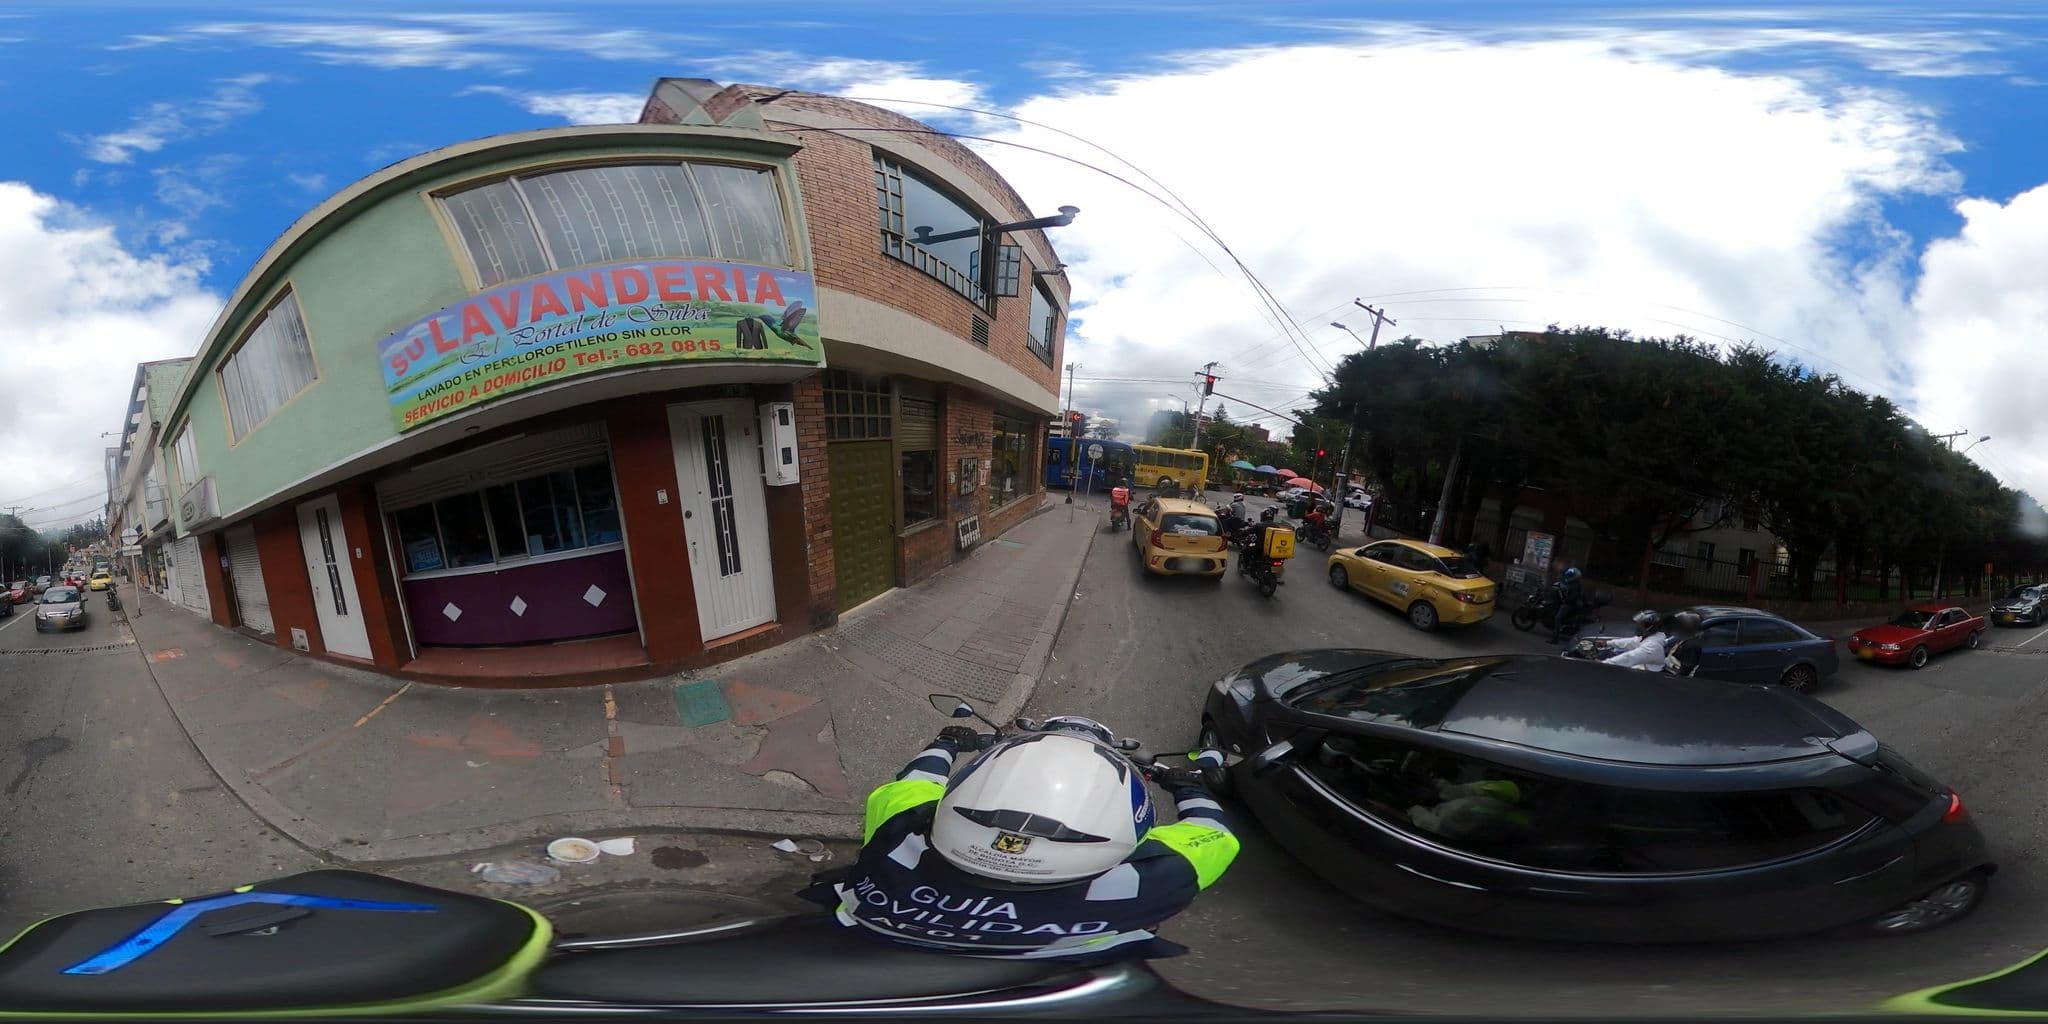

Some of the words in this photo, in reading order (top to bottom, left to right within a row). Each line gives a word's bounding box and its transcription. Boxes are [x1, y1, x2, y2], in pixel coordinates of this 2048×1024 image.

[428, 265, 786, 355] LAVANDERIA
[459, 336, 500, 365] El
[509, 314, 585, 348] Portal
[590, 308, 616, 330] de
[625, 303, 712, 324] Suba
[405, 390, 465, 424] SERVICIO
[469, 384, 480, 399] A
[483, 357, 567, 393] DOMICILIO
[625, 341, 665, 357] 682
[671, 339, 721, 353] 0815
[417, 375, 462, 402] LAVADO
[465, 365, 482, 381] EN
[622, 328, 647, 340] SIN
[650, 326, 692, 337] OLOR
[856, 876, 1109, 935] MOVILIDAD
[910, 885, 1018, 920] GUÍA
